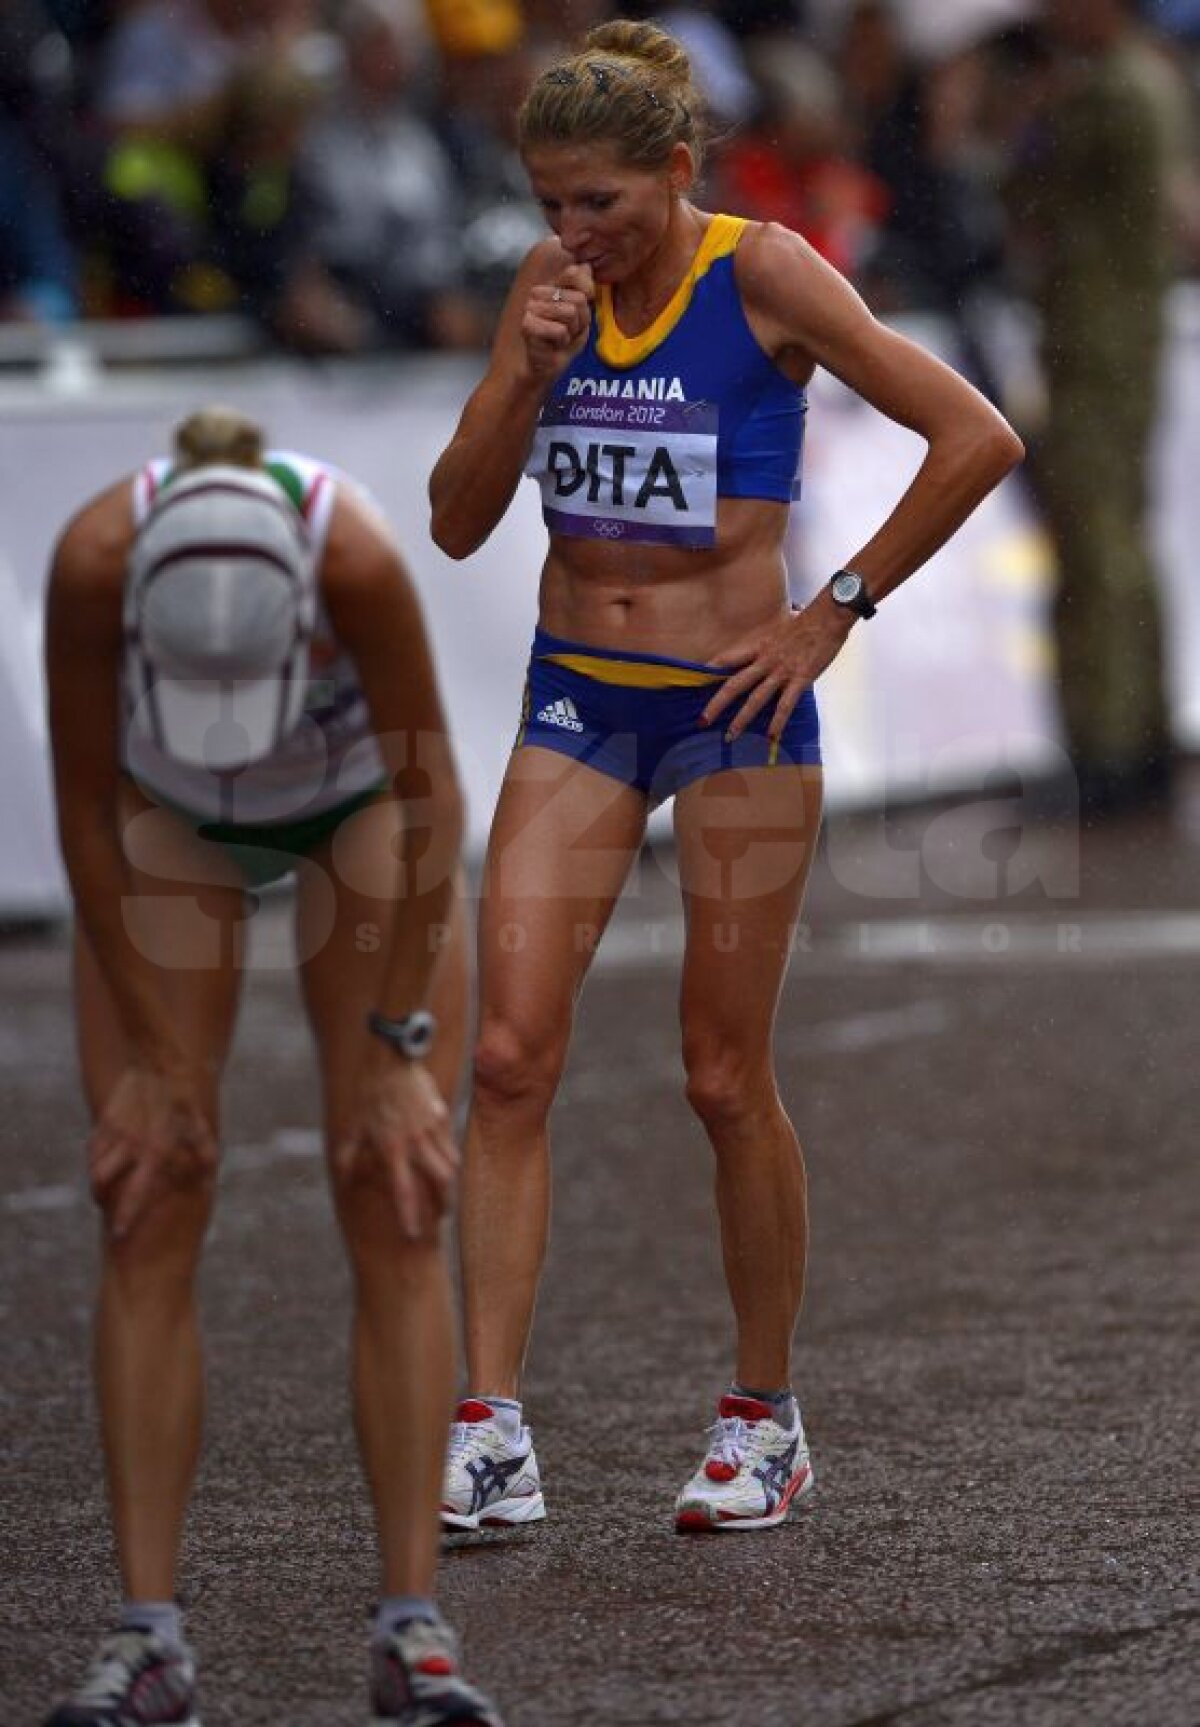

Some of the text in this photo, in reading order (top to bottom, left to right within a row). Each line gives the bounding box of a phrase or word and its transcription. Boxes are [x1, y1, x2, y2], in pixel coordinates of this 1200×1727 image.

[567, 377, 685, 402] ROMANIA
[569, 403, 667, 424] London 2012
[548, 442, 689, 511] DITA
[537, 709, 584, 733] adidas
